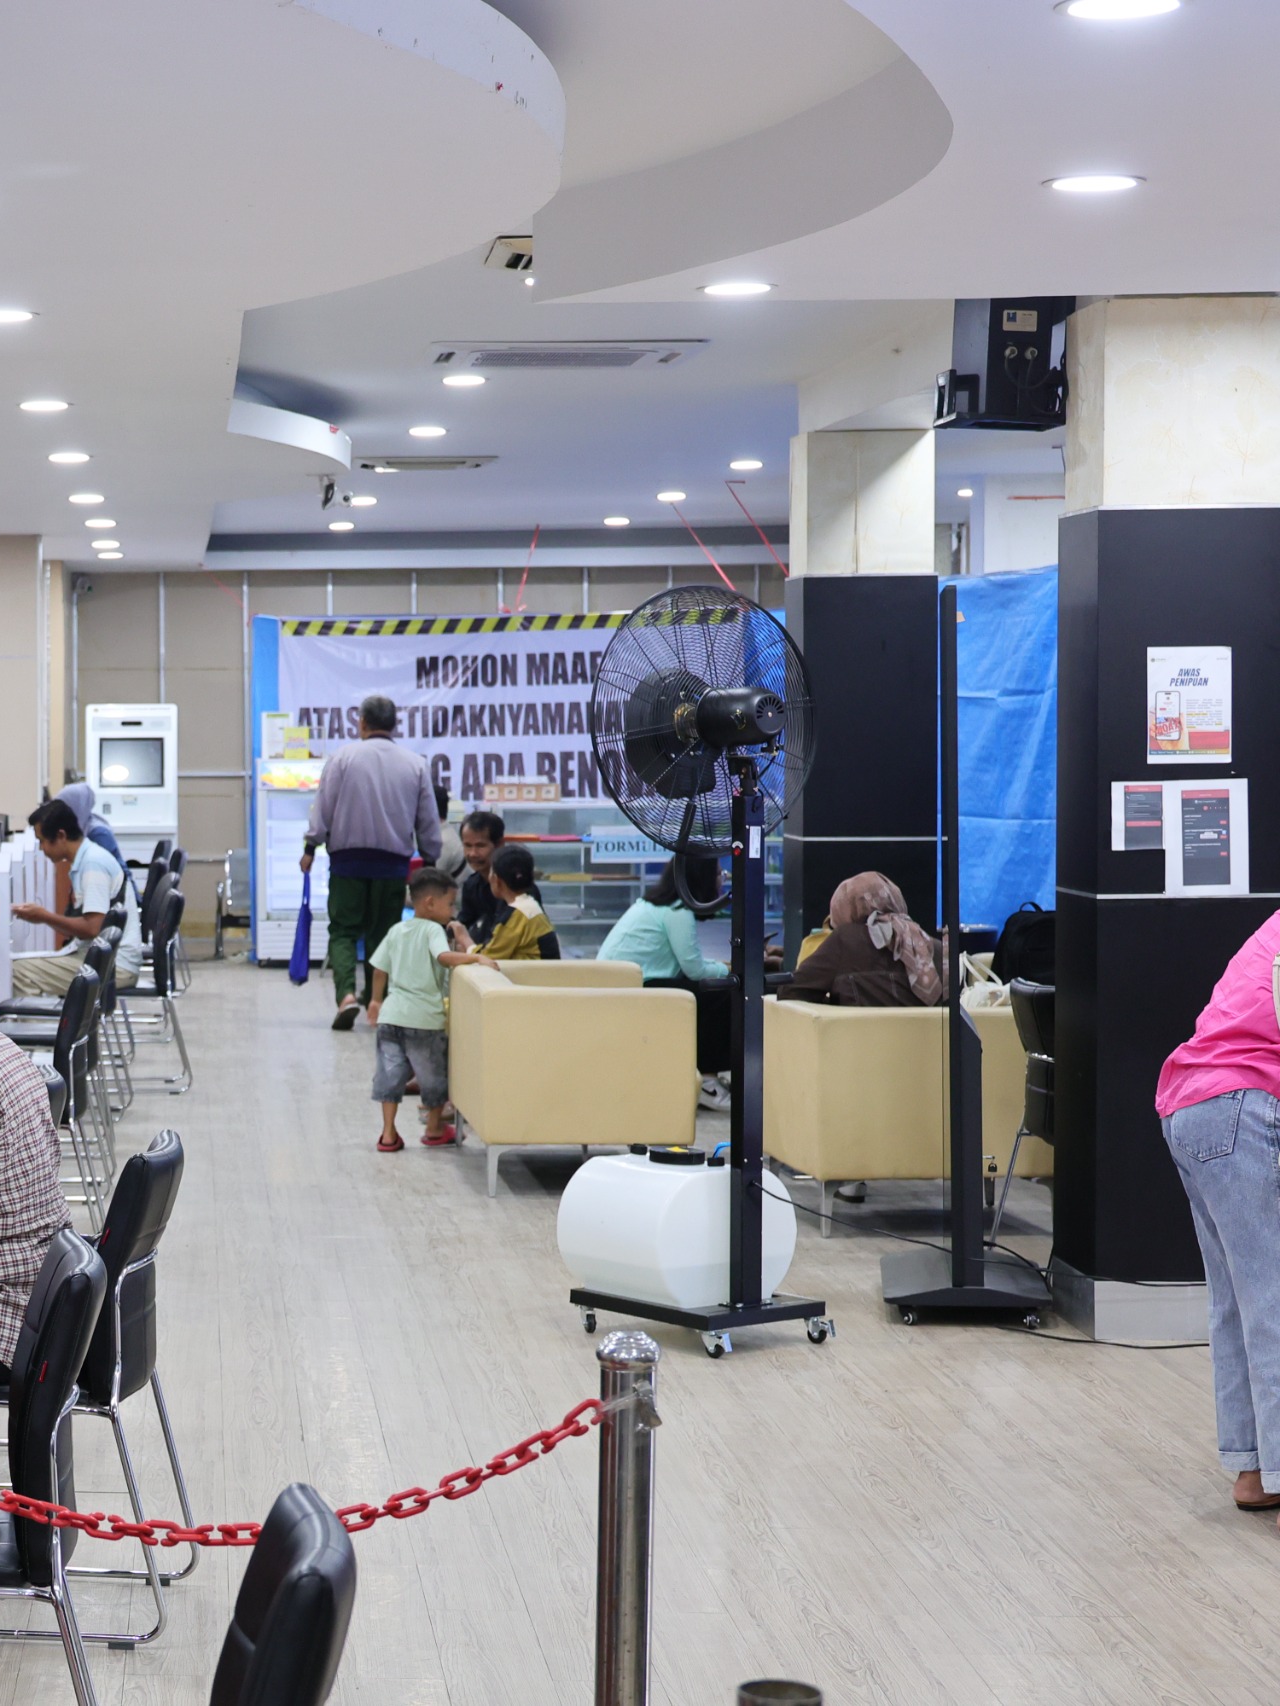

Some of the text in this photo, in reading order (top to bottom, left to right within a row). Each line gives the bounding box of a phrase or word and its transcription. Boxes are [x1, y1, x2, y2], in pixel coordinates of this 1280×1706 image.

[416, 653, 518, 689] MOHON
[1169, 677, 1209, 687] PENIPUAN
[1177, 668, 1201, 678] AWAS
[298, 706, 360, 740] ATAS
